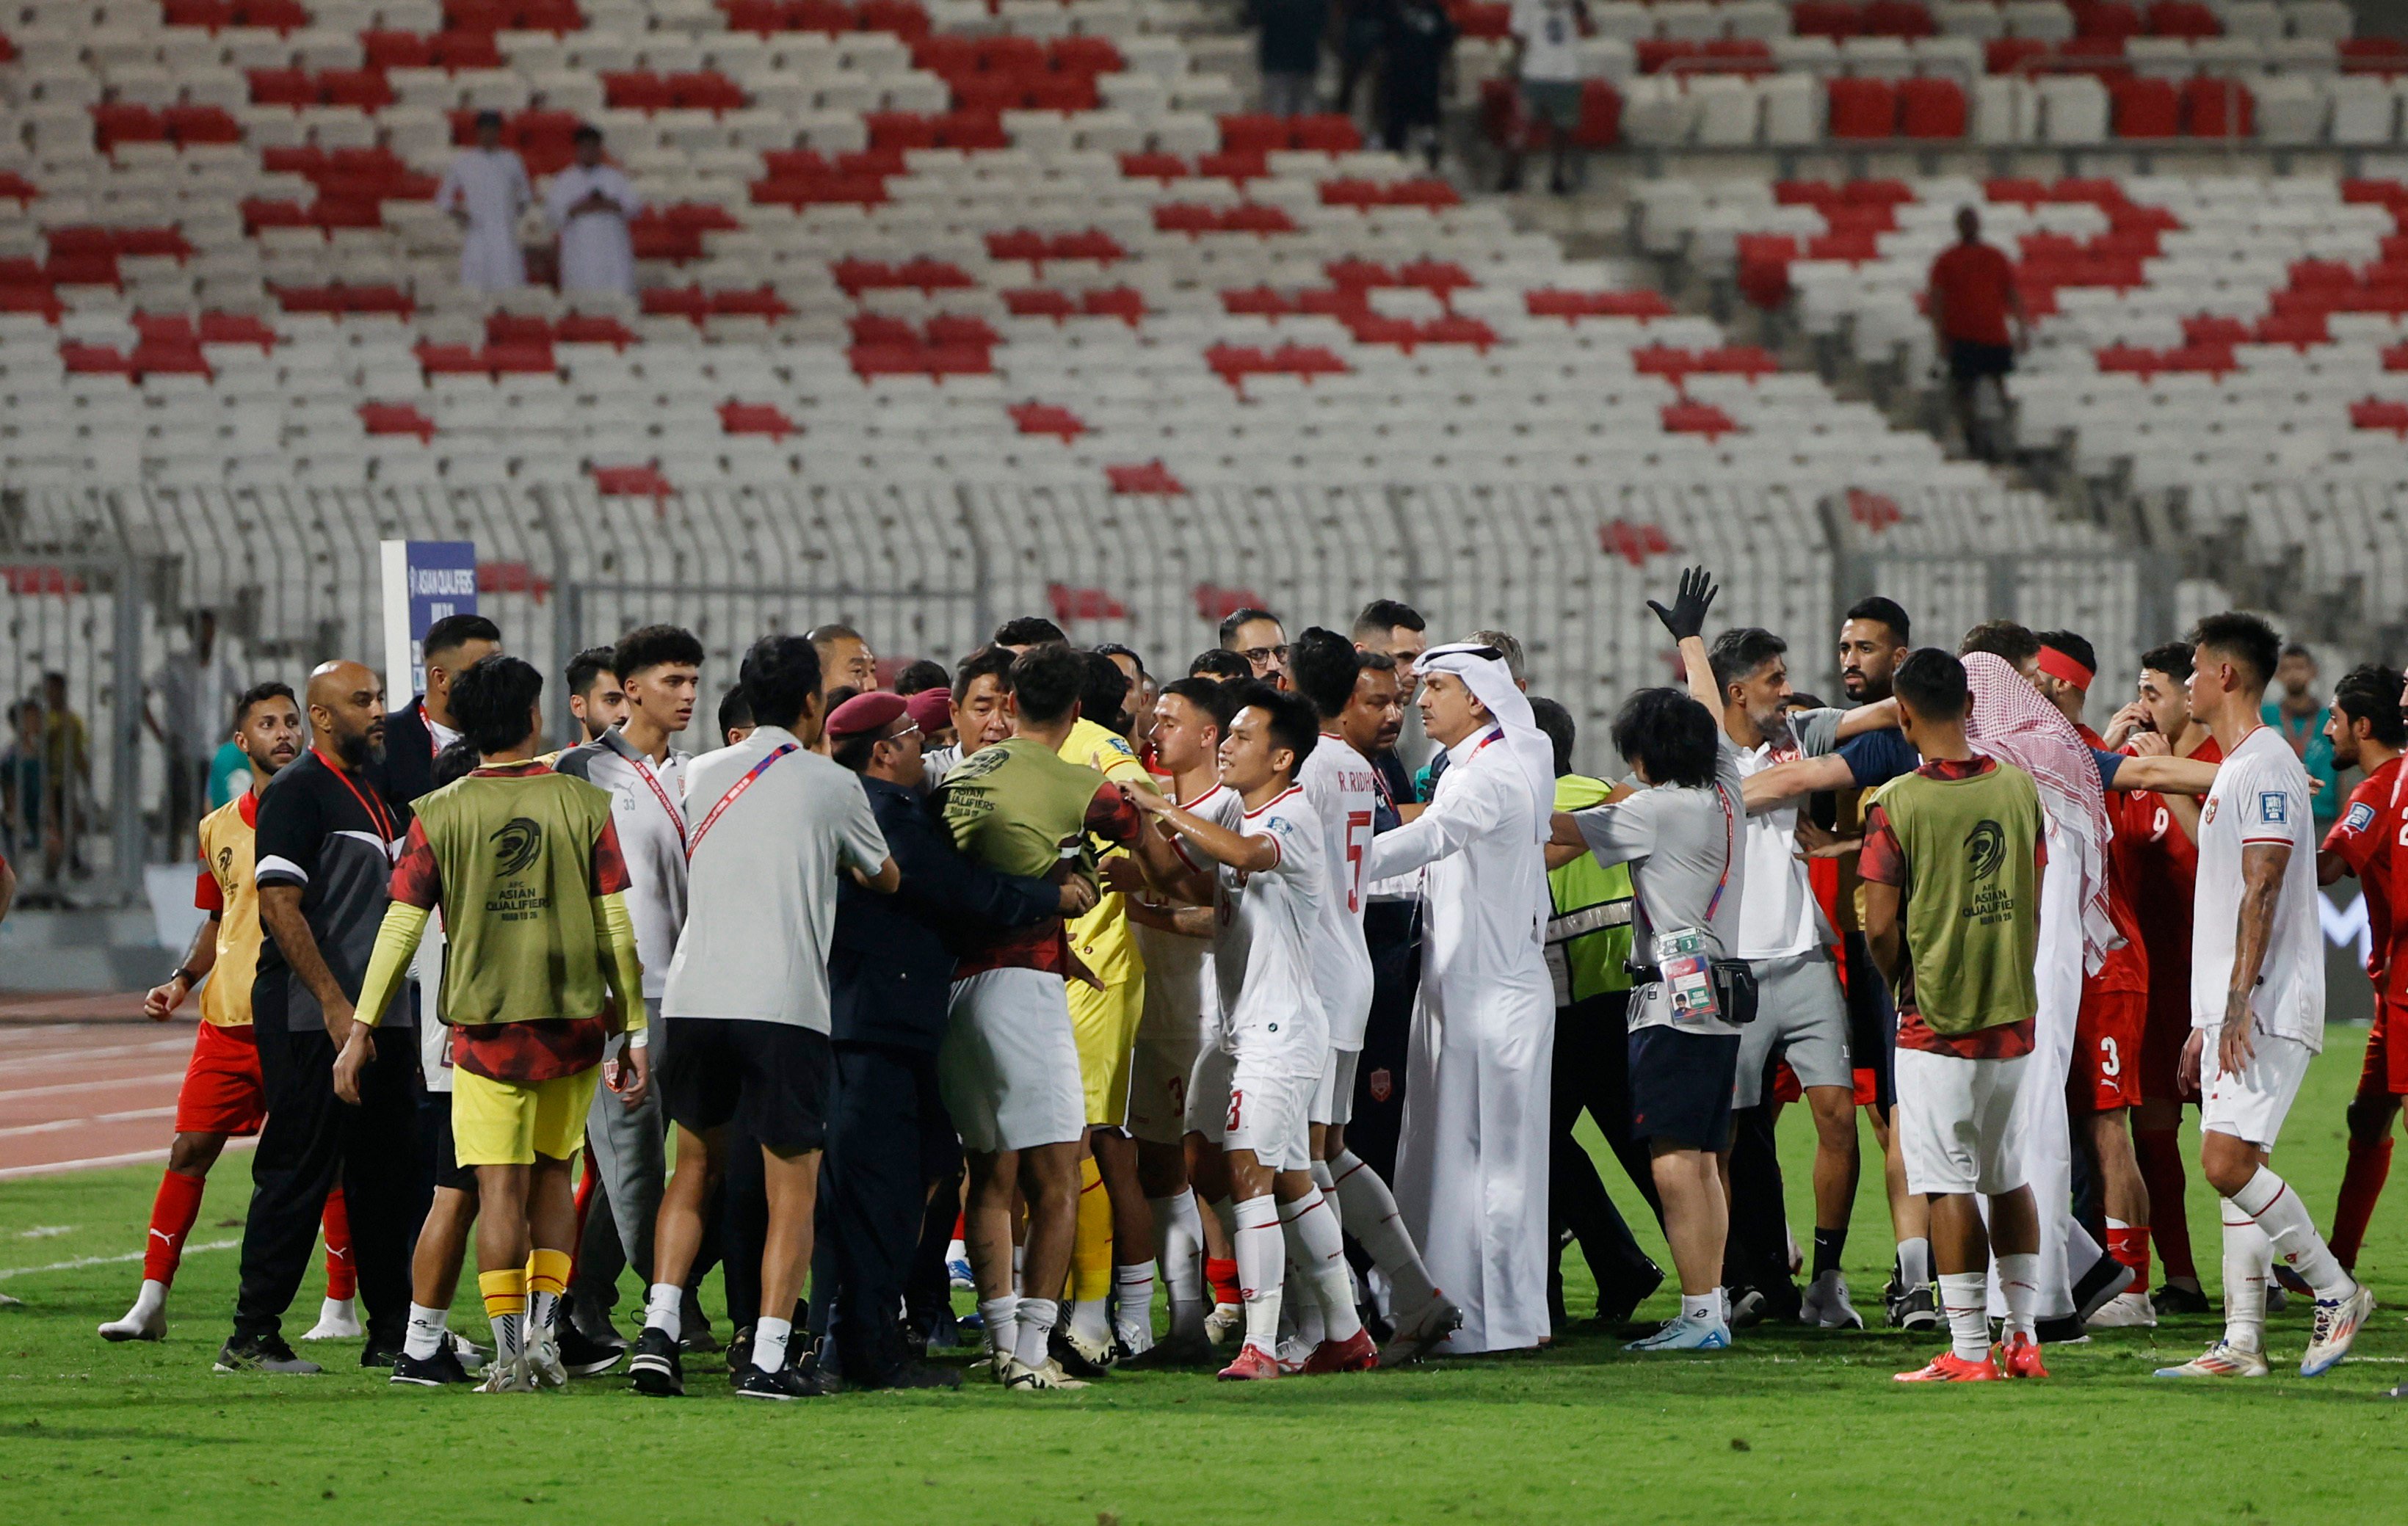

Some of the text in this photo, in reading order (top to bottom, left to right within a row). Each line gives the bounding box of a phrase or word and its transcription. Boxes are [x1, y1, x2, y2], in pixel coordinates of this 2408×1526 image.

[1338, 771, 1349, 793] R.
[623, 798, 636, 811] 33
[947, 794, 996, 811] UALIFIERS
[2149, 807, 2169, 843] 9
[1346, 810, 1372, 915] 5
[499, 888, 535, 900] ASIAN
[1975, 889, 2008, 905] ASIAN
[485, 897, 552, 911] QUALIFIERS
[1686, 940, 1693, 949] 3
[2100, 1036, 2120, 1076] 3
